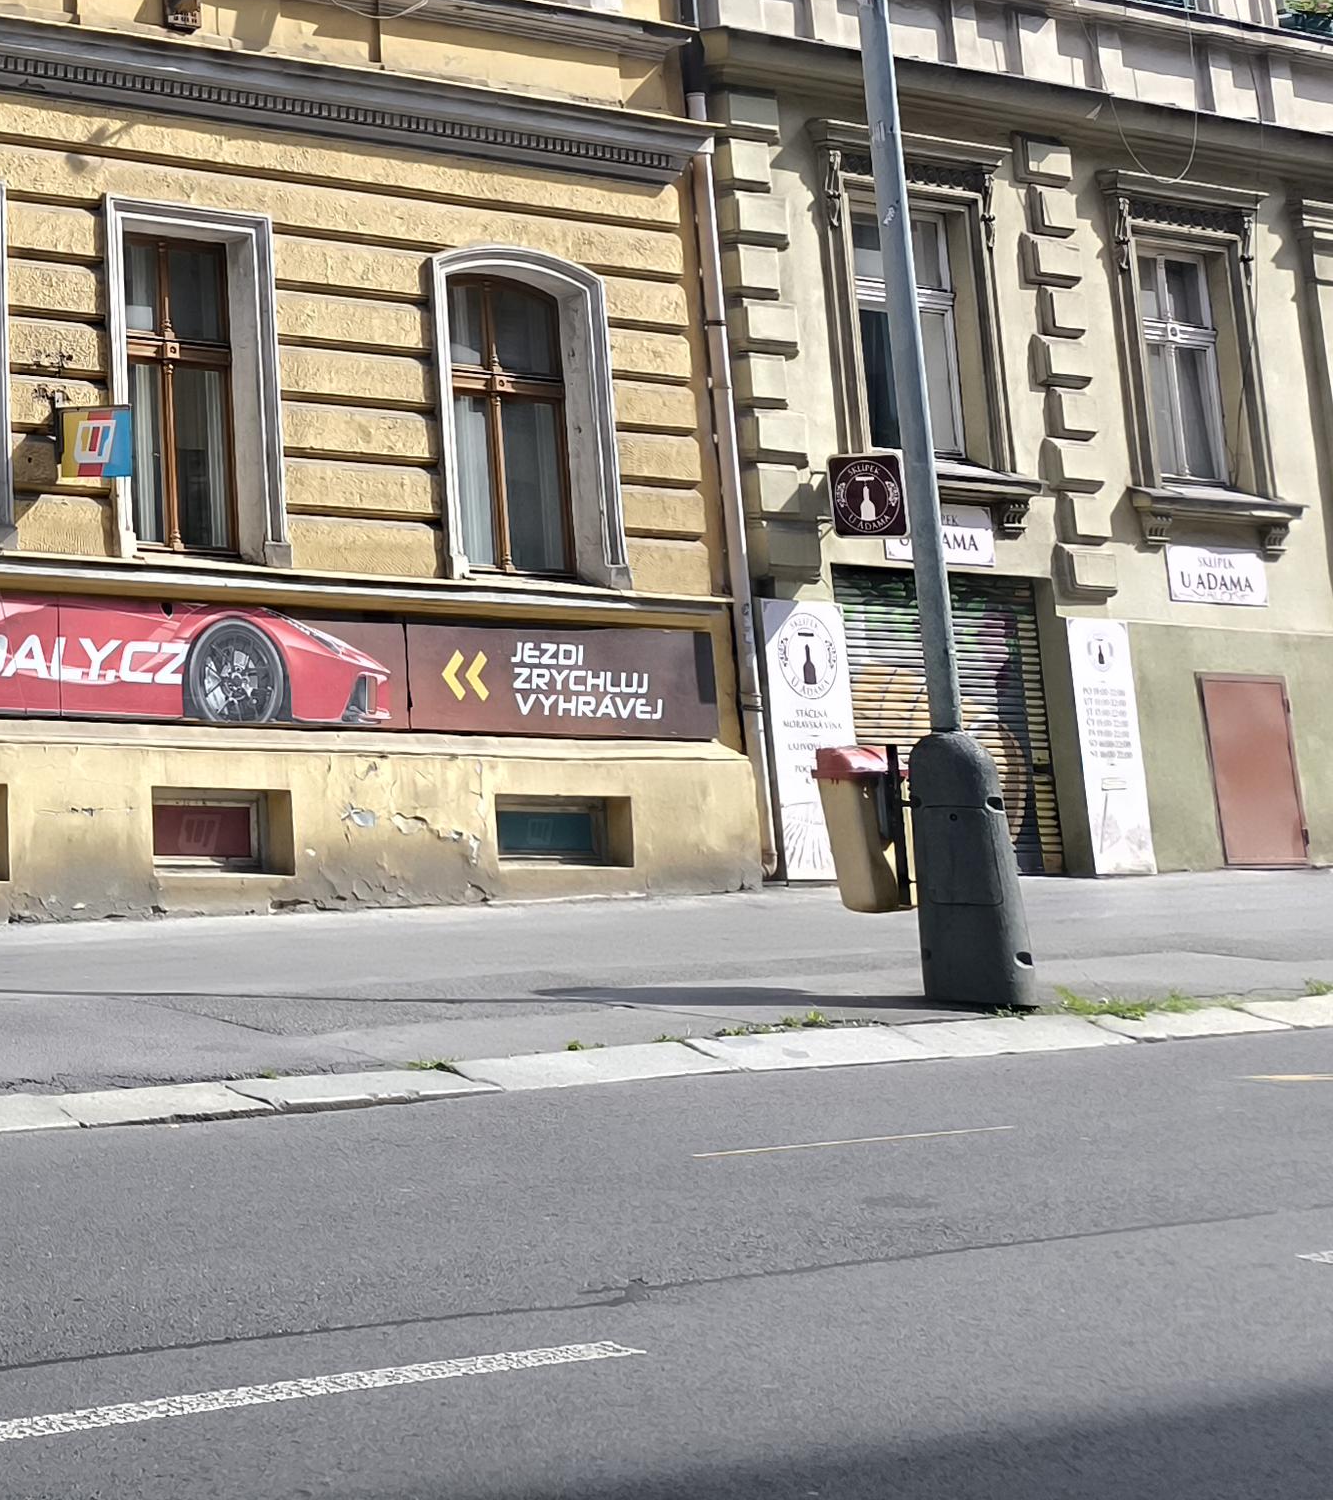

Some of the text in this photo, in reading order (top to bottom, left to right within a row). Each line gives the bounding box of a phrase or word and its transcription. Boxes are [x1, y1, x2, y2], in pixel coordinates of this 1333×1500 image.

[857, 514, 891, 531] ADAMA
[942, 532, 979, 551] AMA
[1180, 571, 1254, 592] U ADAMA
[510, 642, 584, 666] JEZDI
[513, 667, 649, 694] ZRYCHLUJ
[516, 693, 664, 720] VYHRÁVEJ
